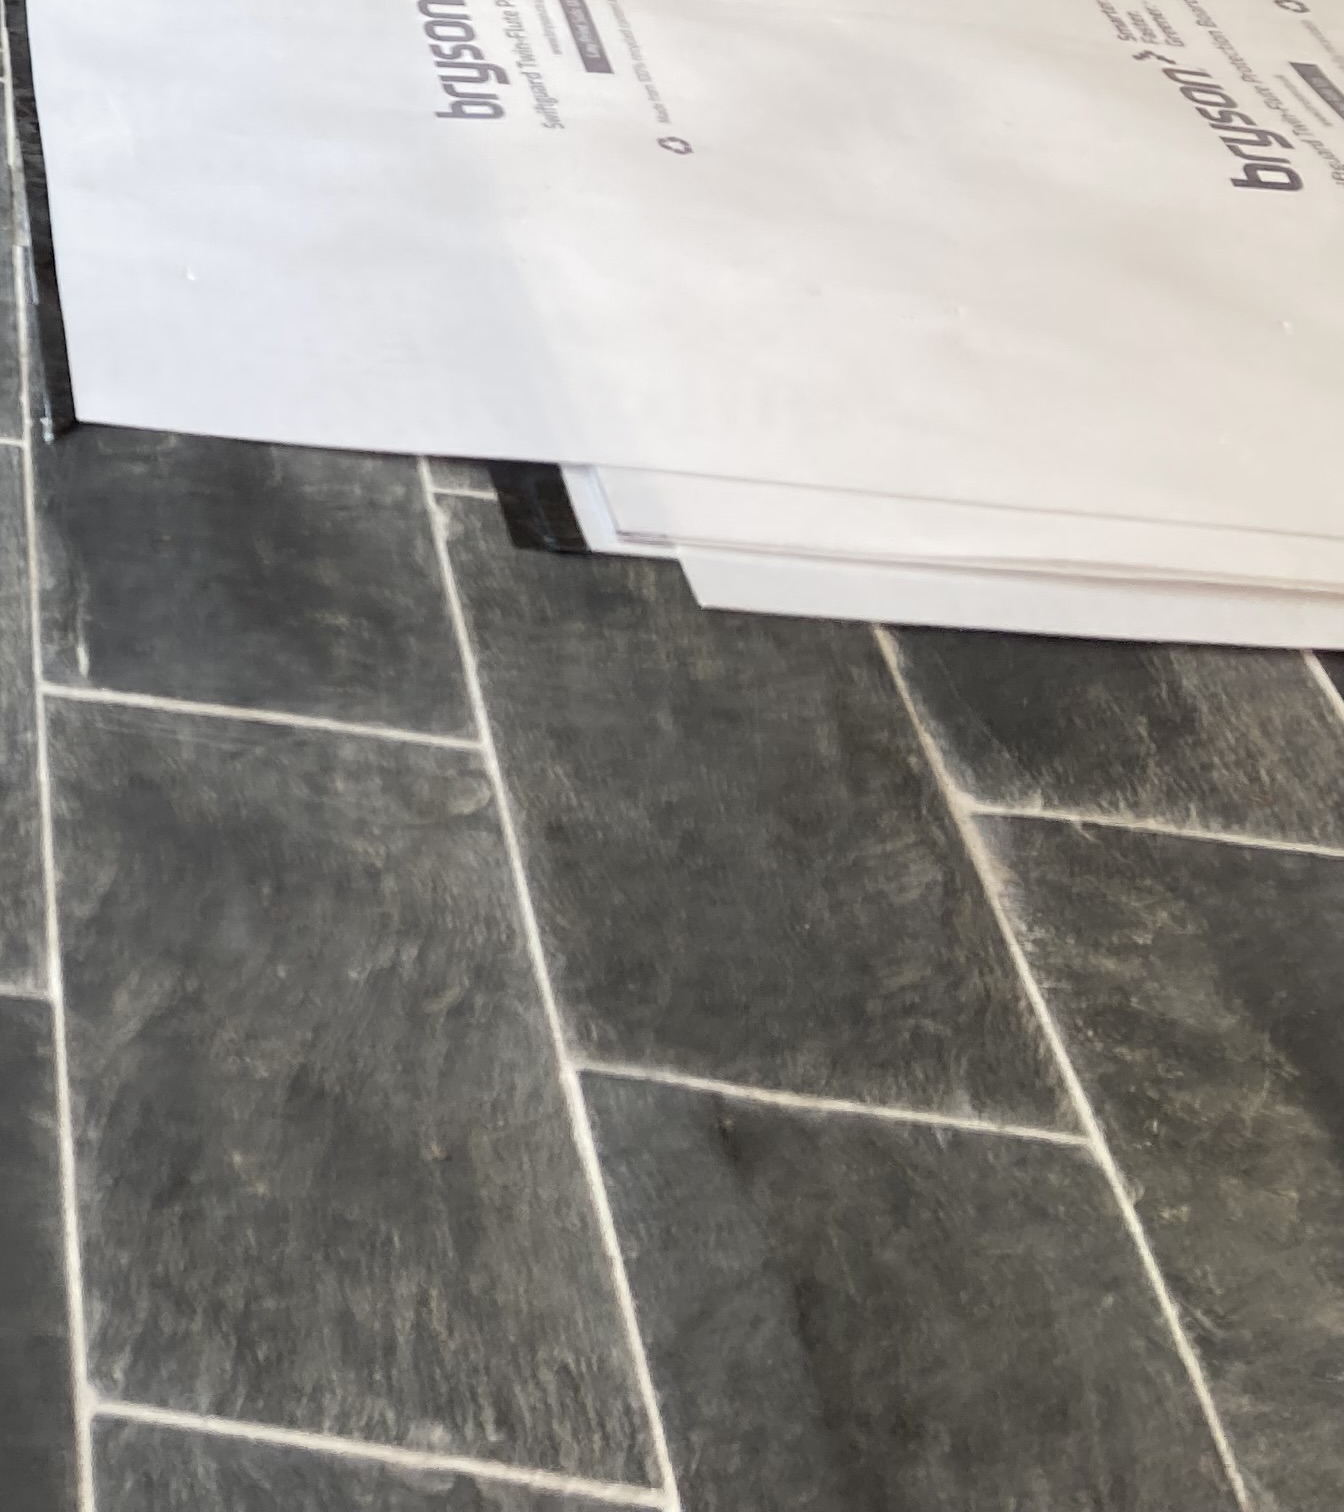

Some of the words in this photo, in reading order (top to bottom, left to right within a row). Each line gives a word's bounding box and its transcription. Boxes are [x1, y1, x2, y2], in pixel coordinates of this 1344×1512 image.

[502, 10, 538, 68] Twin-Flute
[1208, 30, 1263, 84] Protection
[519, 71, 565, 129] Swiftguard
[1161, 67, 1304, 191] bryson
